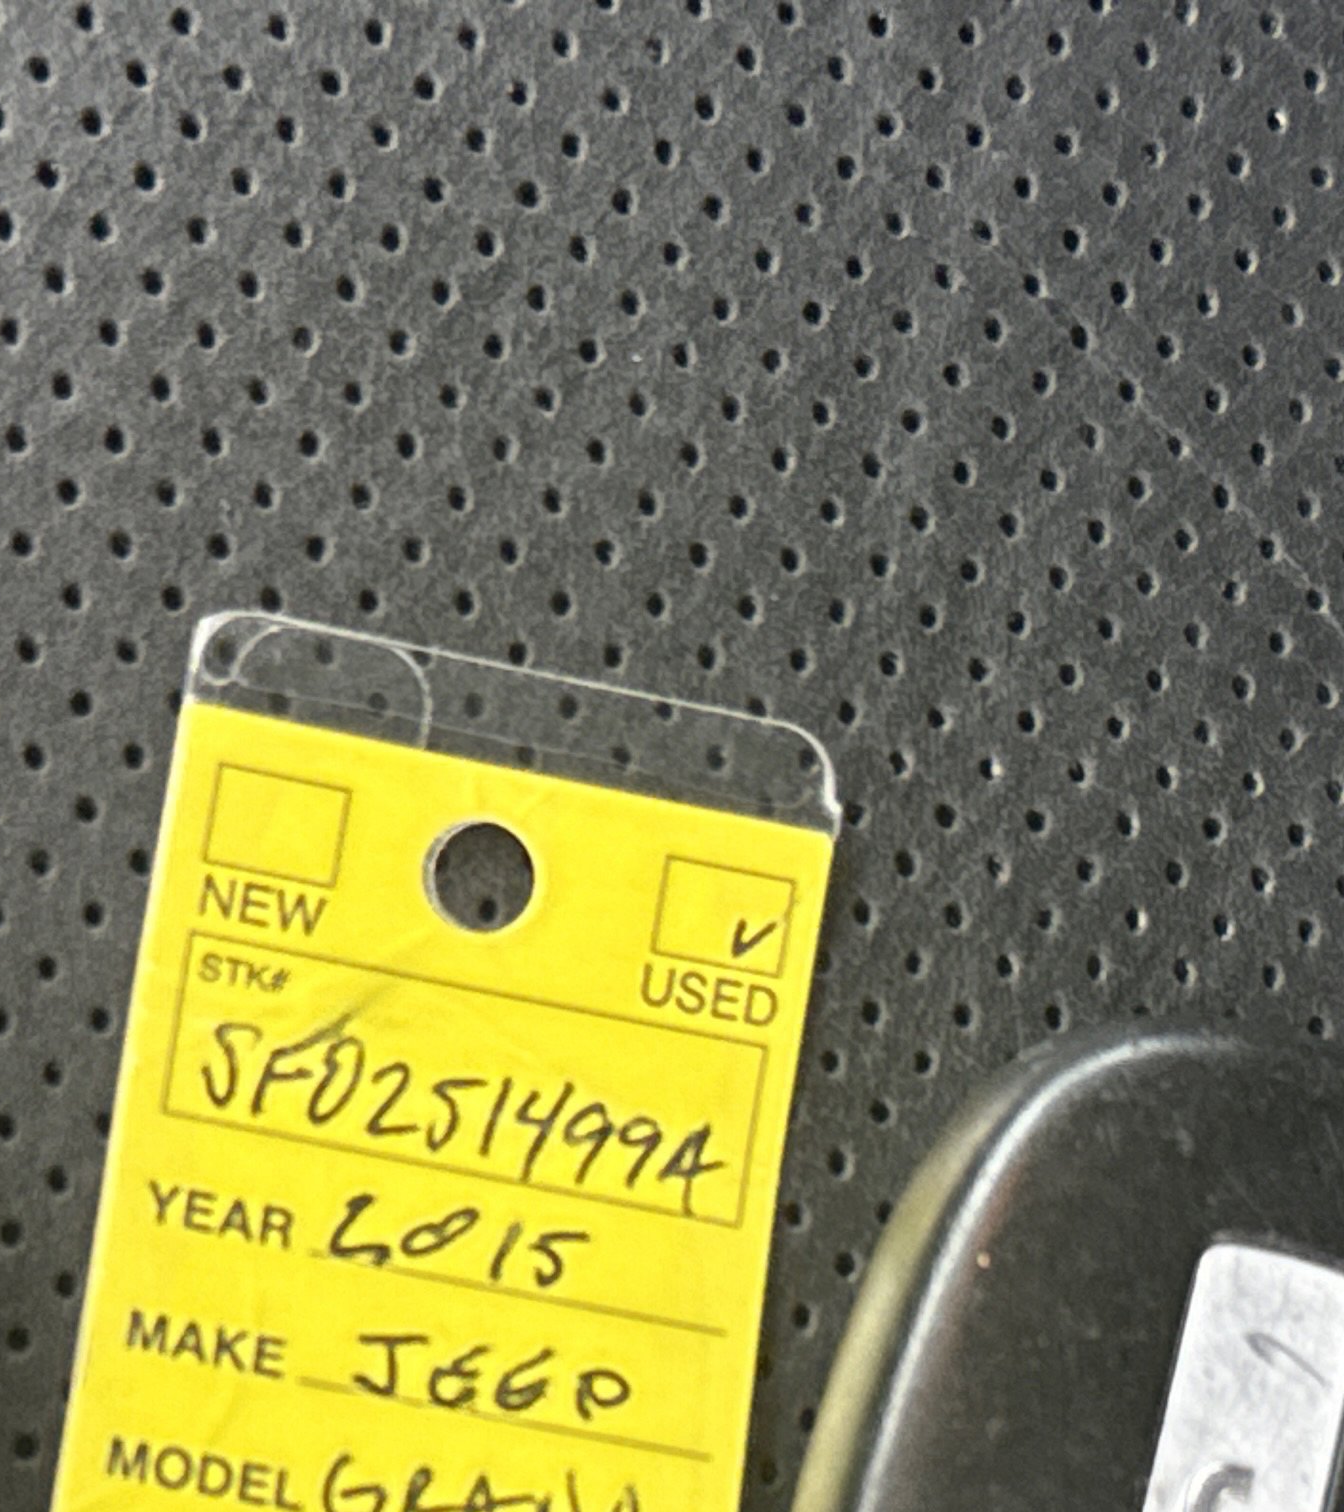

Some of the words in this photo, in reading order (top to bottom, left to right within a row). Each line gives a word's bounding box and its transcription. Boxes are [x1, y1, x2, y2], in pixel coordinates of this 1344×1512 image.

[199, 874, 330, 937] NEW
[197, 952, 292, 993] STK#
[640, 964, 779, 1028] USED
[147, 1182, 294, 1250] YEAR
[328, 1193, 590, 1289] 2015
[126, 1309, 286, 1379] MAKE
[351, 1332, 632, 1421] JEEP
[106, 1437, 303, 1512] MODEL
